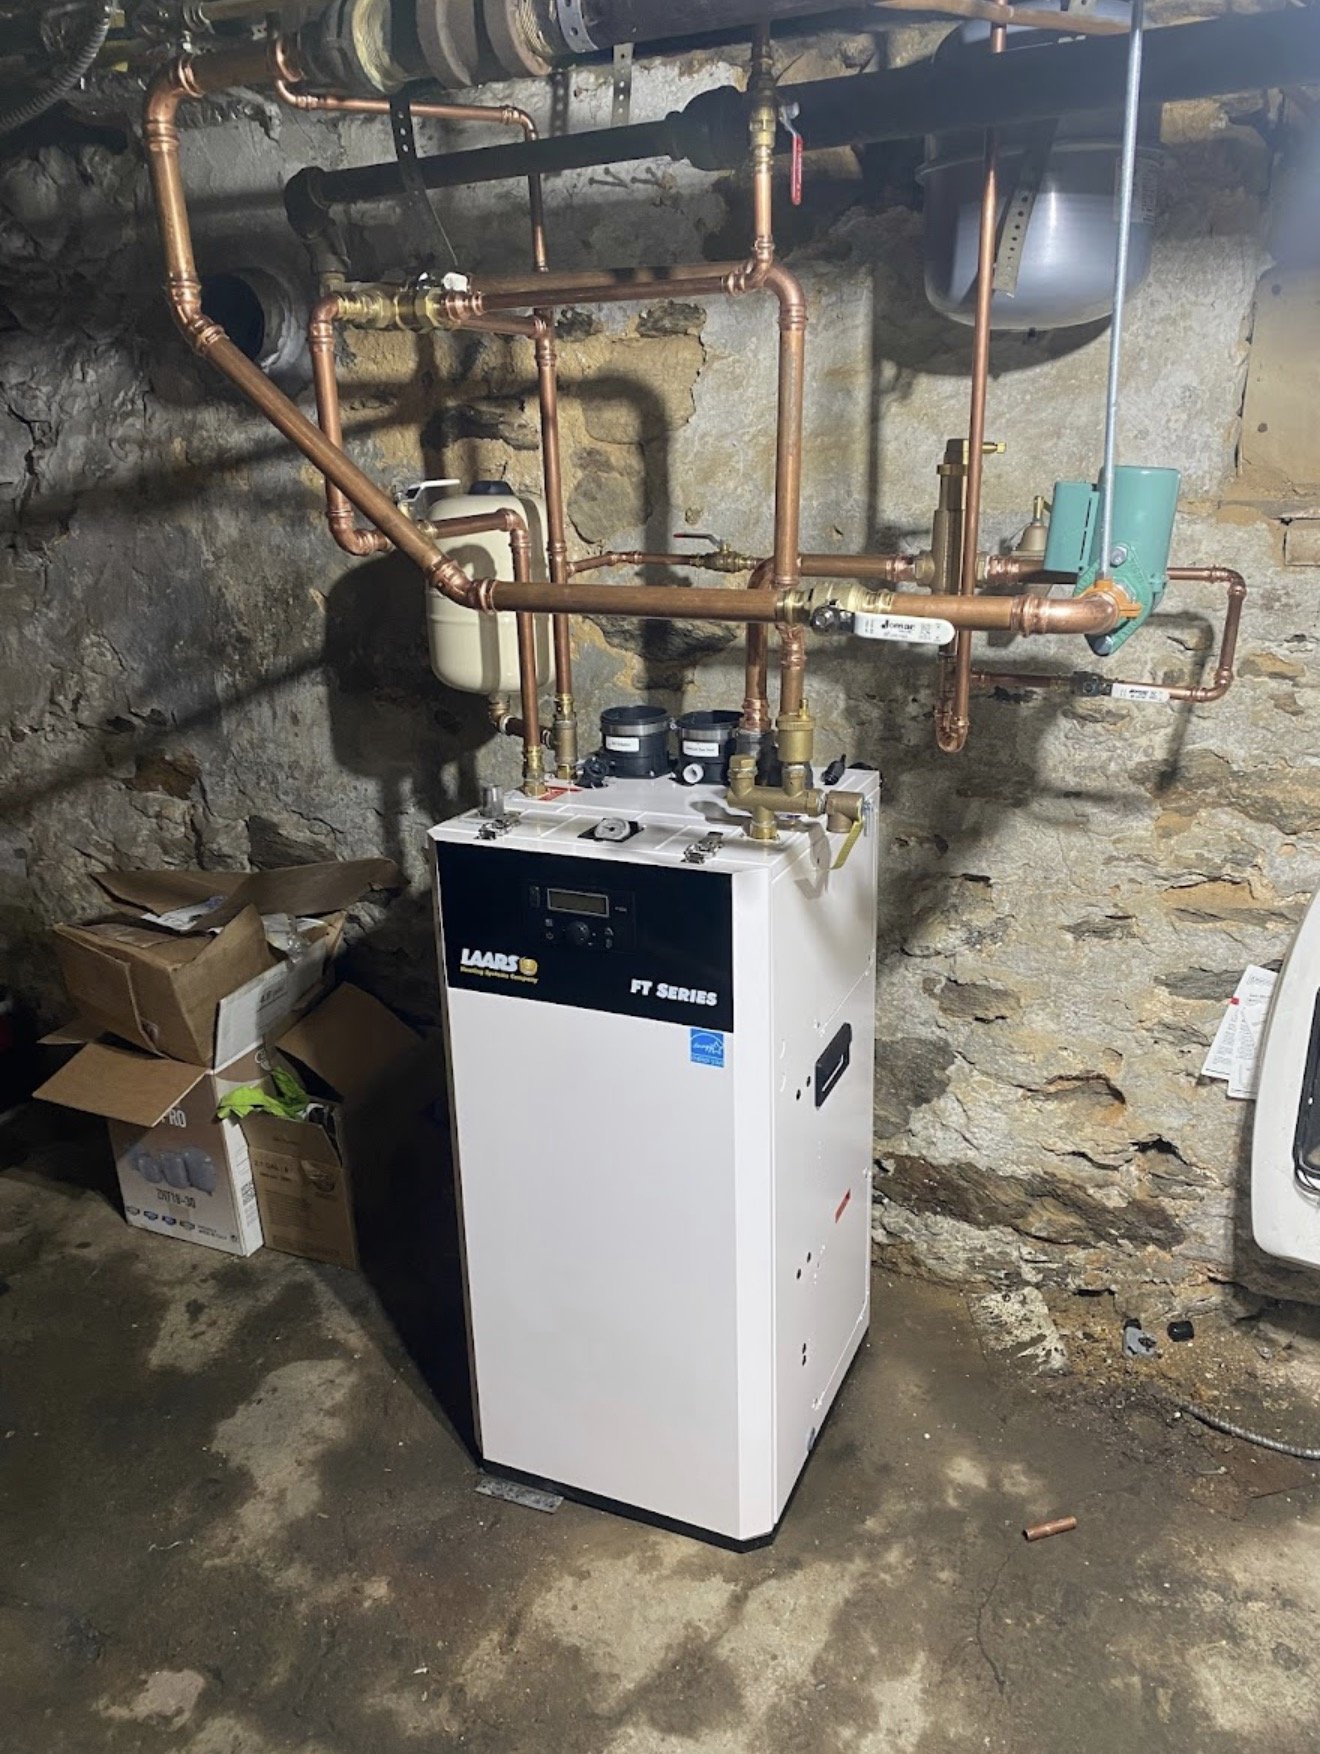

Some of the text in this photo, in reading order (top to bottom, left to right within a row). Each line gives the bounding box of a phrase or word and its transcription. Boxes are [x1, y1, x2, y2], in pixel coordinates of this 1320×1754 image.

[881, 619, 915, 630] Jomar
[461, 948, 519, 972] LAARS
[630, 979, 653, 996] FT
